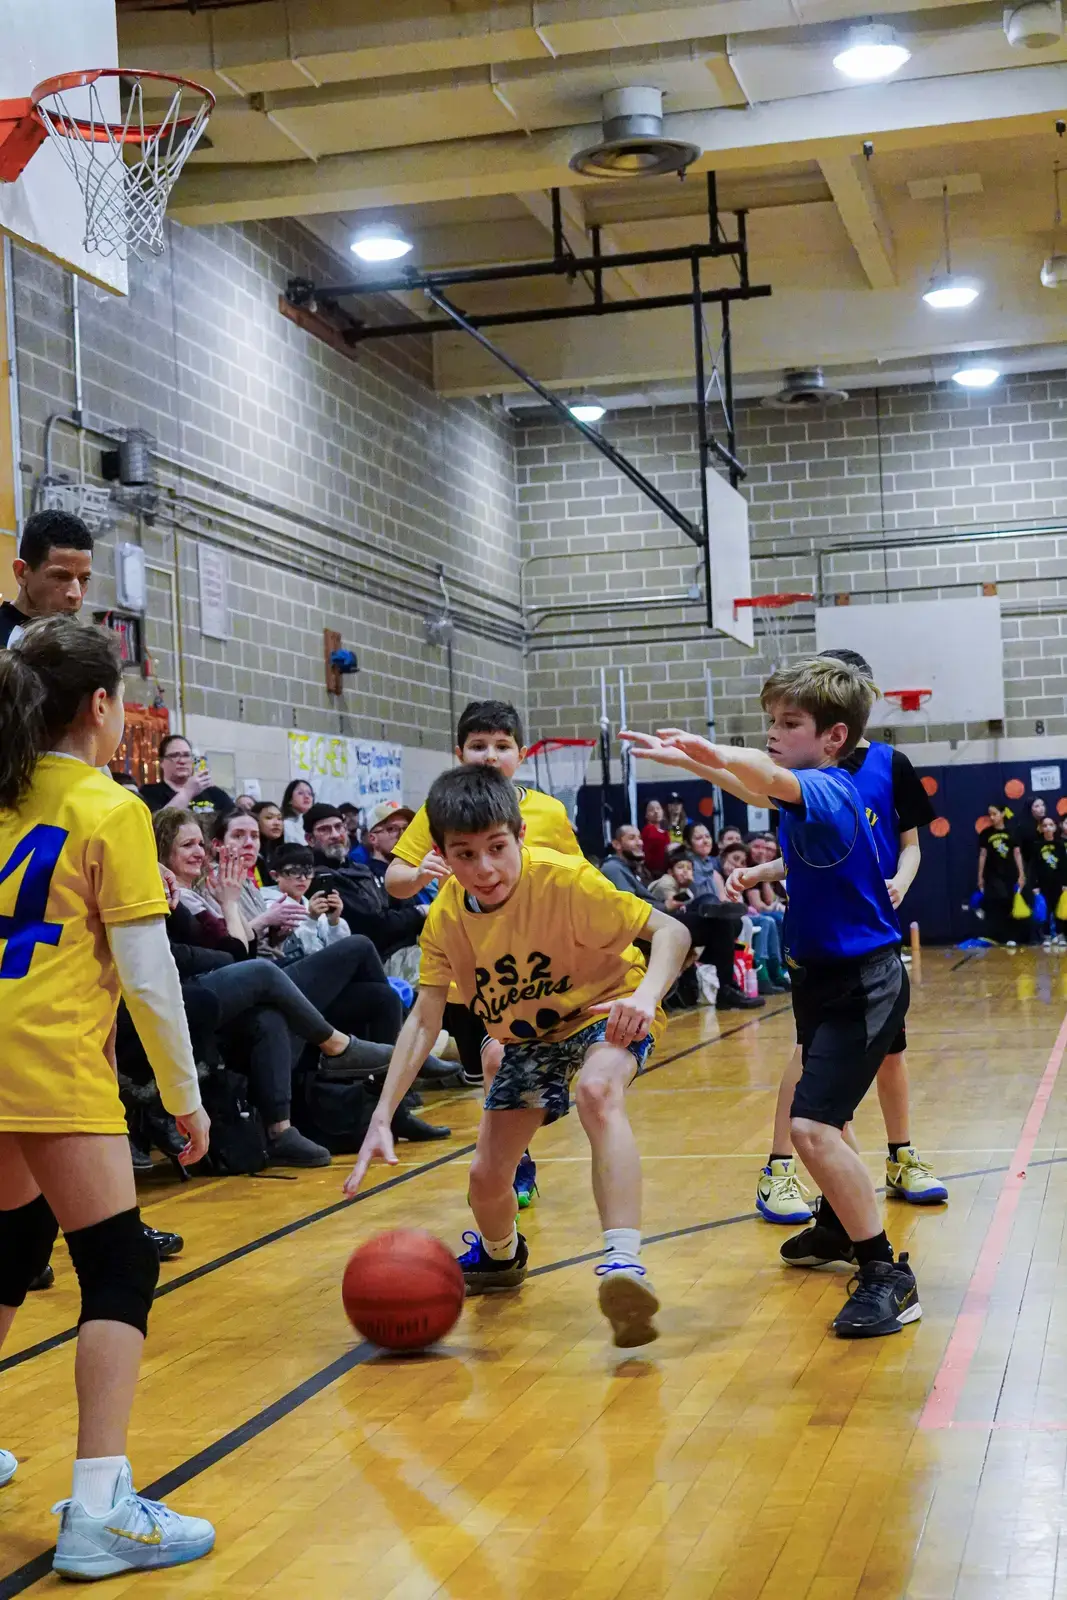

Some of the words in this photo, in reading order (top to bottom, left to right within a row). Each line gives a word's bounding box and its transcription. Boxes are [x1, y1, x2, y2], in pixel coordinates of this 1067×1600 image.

[885, 728, 892, 744] 9
[1035, 720, 1044, 735] 8
[0, 823, 70, 979] 4
[475, 951, 551, 998] P.S.2
[470, 975, 573, 1023] Queens
